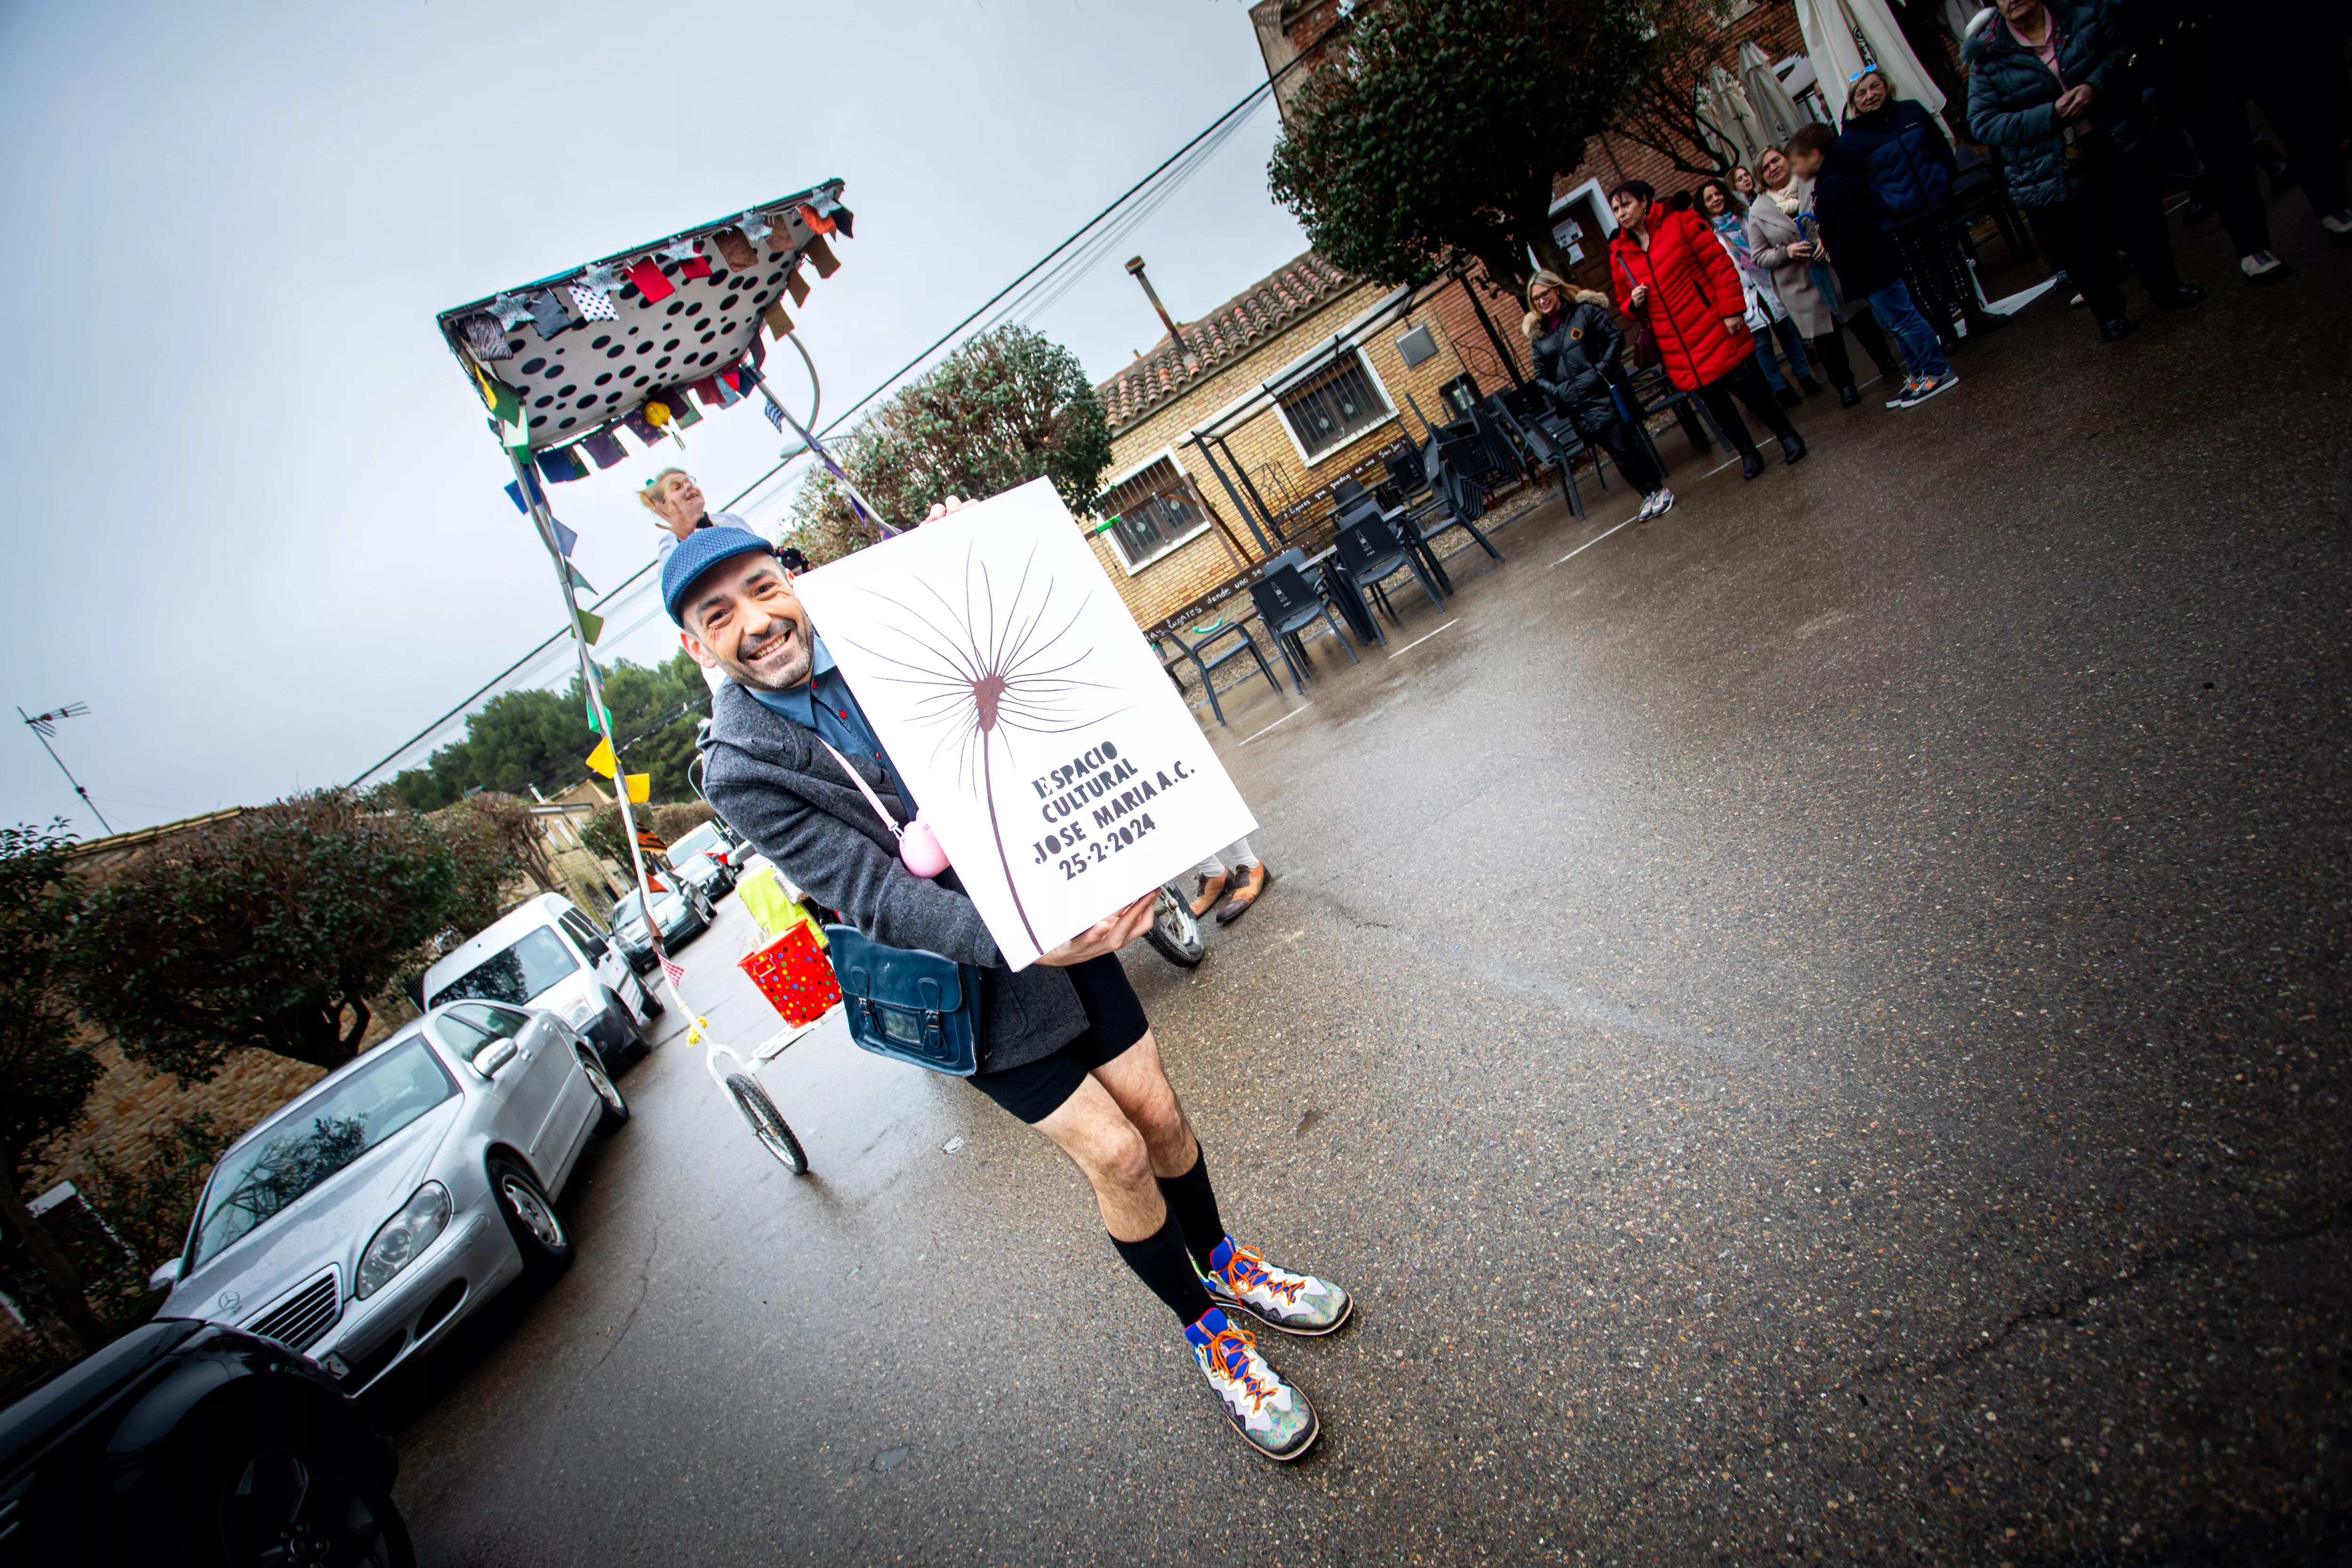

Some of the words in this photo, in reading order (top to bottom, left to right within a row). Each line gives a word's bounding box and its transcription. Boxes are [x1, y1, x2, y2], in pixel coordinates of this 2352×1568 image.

[1315, 490, 1327, 500] que
[1330, 473, 1351, 489] quedan
[1389, 440, 1406, 452] Jore
[1166, 606, 1202, 629] lugares
[1207, 587, 1231, 604] donde
[1234, 577, 1248, 589] uno
[1252, 568, 1263, 577] se
[1032, 741, 1117, 799] ESPACIO
[1042, 758, 1138, 823] CULTURAL
[1033, 821, 1087, 864] JOSE
[1092, 780, 1158, 829] MARIA
[1156, 761, 1194, 791] A.C.
